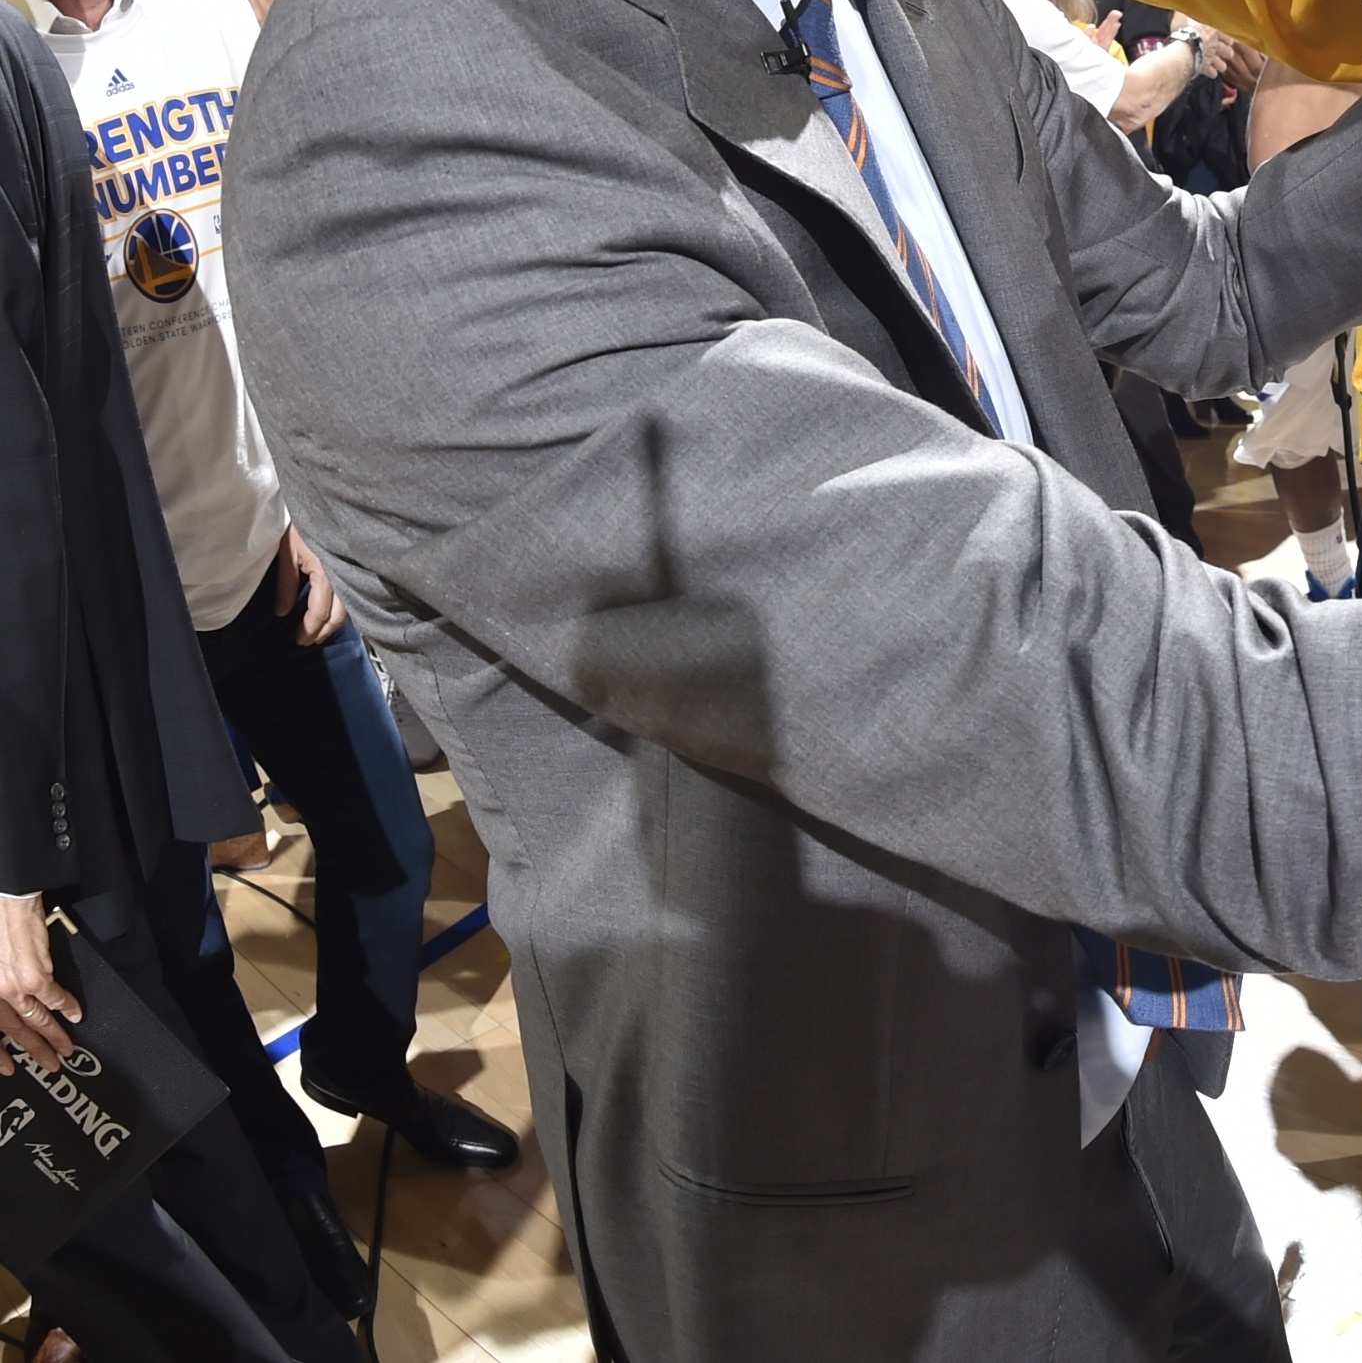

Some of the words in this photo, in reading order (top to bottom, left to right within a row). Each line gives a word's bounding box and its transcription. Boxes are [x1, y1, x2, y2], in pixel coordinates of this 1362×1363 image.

[106, 82, 135, 97] adidas
[149, 305, 209, 330] CONFERENCE
[159, 327, 187, 341] STATE
